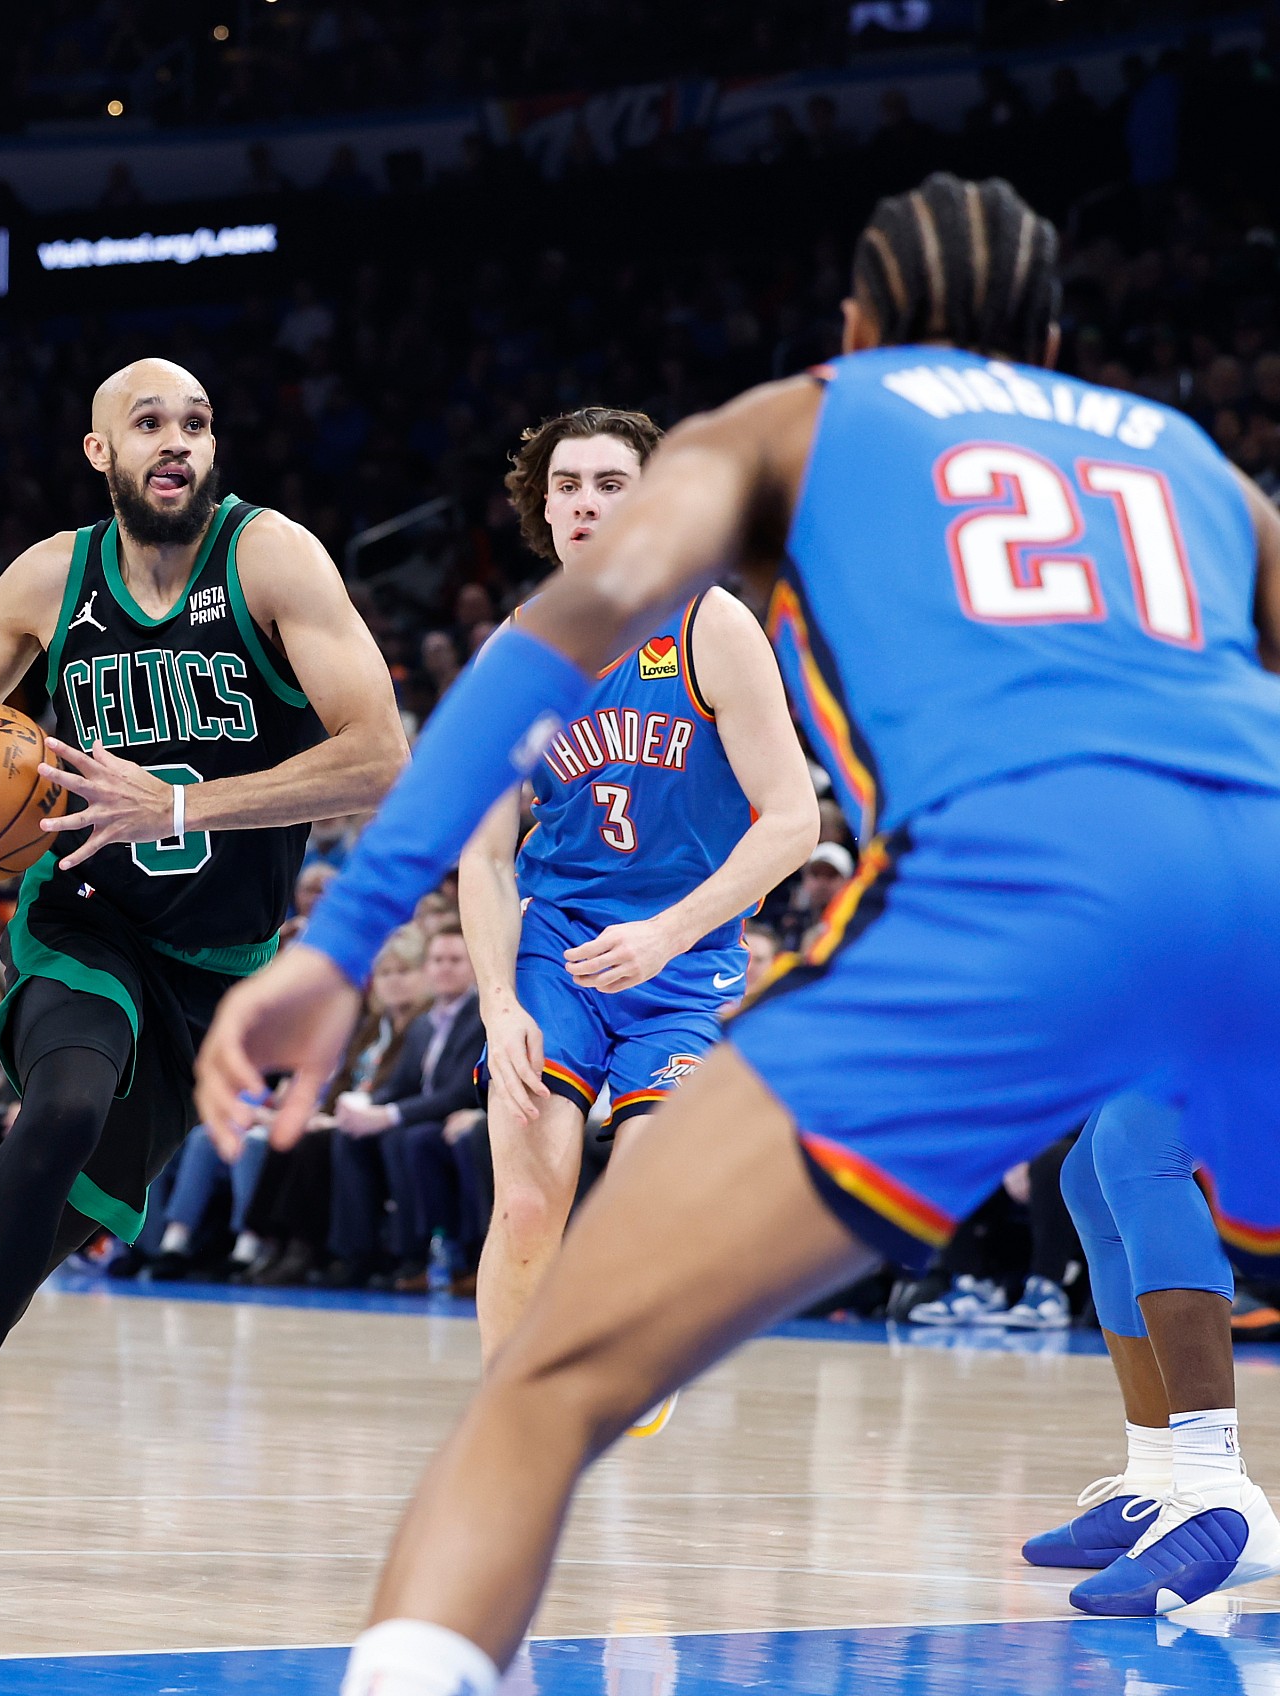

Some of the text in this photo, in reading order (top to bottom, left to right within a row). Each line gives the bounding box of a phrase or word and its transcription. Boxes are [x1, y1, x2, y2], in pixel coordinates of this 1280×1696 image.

[882, 361, 1166, 449] WIGGINS
[932, 439, 1204, 652] 21
[189, 585, 226, 611] VISTA
[190, 604, 226, 626] PRINT
[63, 648, 258, 753] CELTICS
[591, 782, 639, 854] 3
